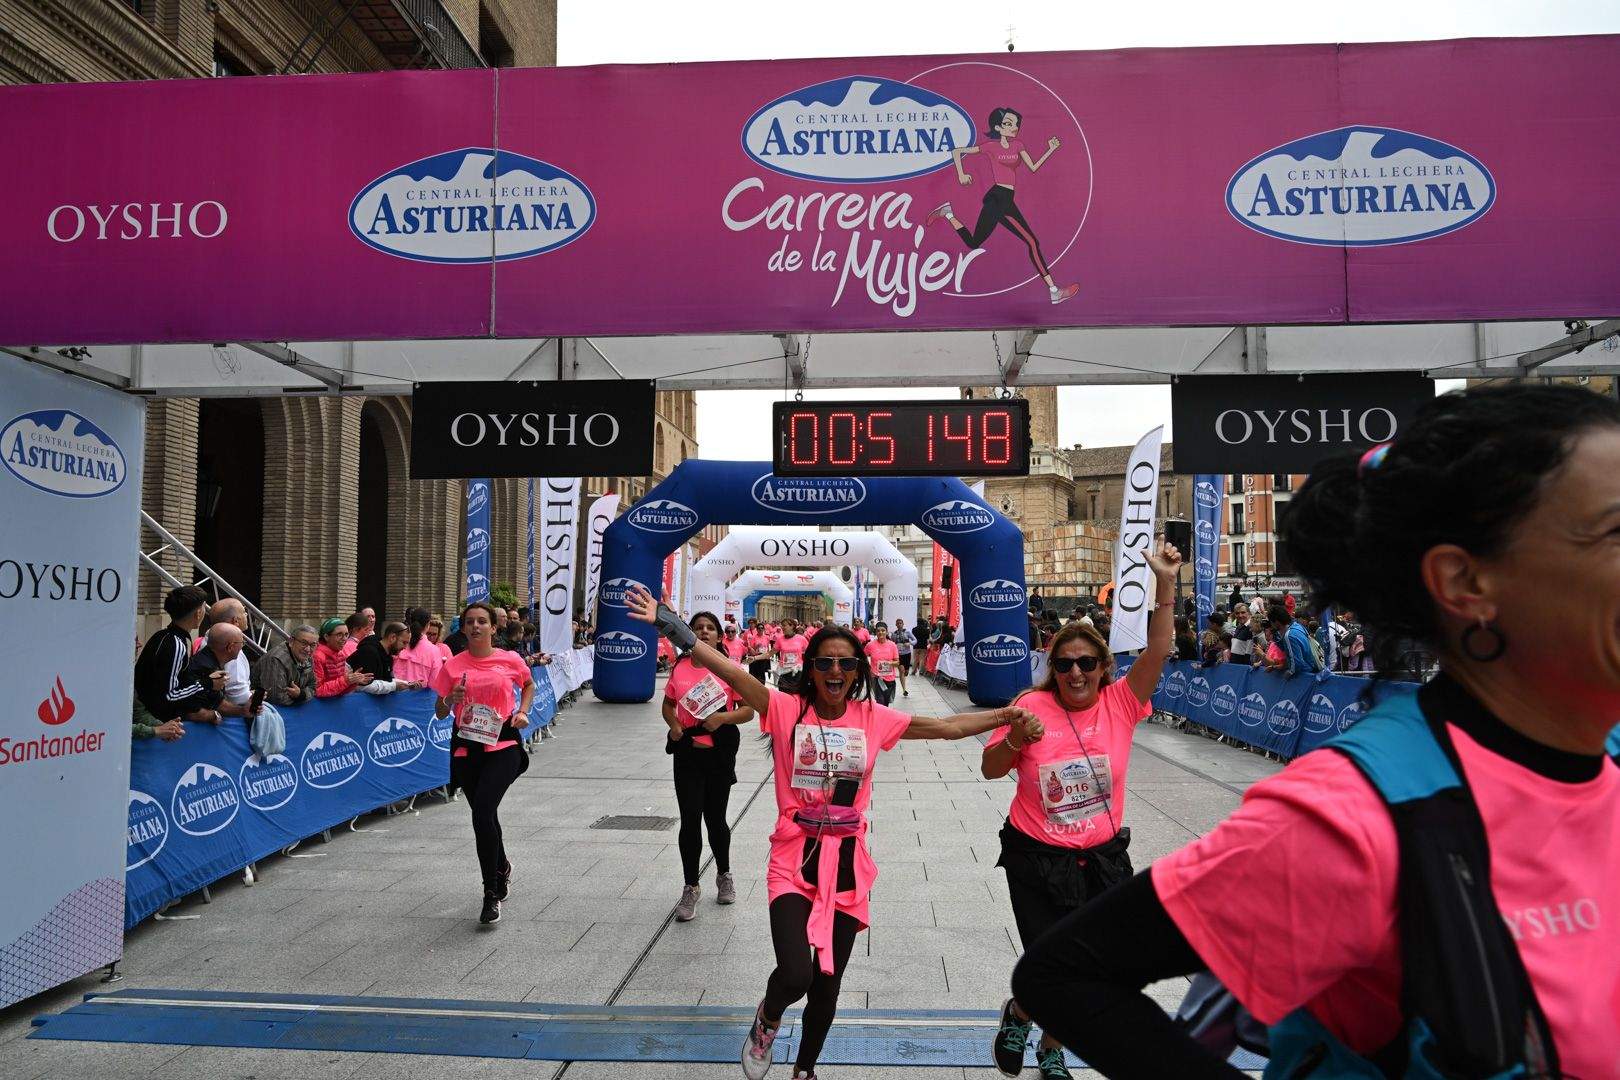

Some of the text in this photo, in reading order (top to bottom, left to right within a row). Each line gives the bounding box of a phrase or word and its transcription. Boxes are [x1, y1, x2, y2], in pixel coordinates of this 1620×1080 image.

[796, 111, 950, 125] CENTRAL LECHERA
[760, 117, 955, 156] ASTURIANA
[1288, 165, 1465, 181] CENTRAL LECHERA
[405, 185, 568, 201] CENTRAL LECHERA
[721, 177, 912, 232] Carrera
[1247, 173, 1475, 217] ASTURIANA
[47, 200, 228, 243] OYSHO
[367, 193, 577, 236] ASTURIANA
[767, 225, 987, 317] de la Mujer
[451, 412, 620, 447] OYSHO
[1215, 407, 1398, 444] OYSHO
[8, 430, 118, 482] ASTURIANA
[31, 432, 115, 458] CENTRAL LECHERA
[760, 481, 857, 501] ASTURIANA
[1246, 475, 1255, 514] OTEL
[632, 510, 692, 524] ASTURIANA
[928, 513, 990, 525] ASTURIANA
[760, 539, 849, 557] OYSHO
[1118, 461, 1155, 613] OYSHO
[708, 558, 735, 566] OYSHO
[0, 559, 121, 603] OYSHO
[974, 592, 1022, 603] ASTURIANA
[597, 643, 643, 654] ASTURIANA
[975, 646, 1025, 658] ASTURIANA
[0, 729, 105, 765] Santander
[373, 736, 422, 760] ASTURIANA
[819, 751, 843, 762] 016
[307, 751, 361, 780] ASTURIANA
[244, 772, 295, 800] ASTURIANA
[1065, 783, 1089, 794] 016
[179, 788, 237, 825] ASTURIANA
[128, 816, 165, 846] RIANA
[1502, 899, 1600, 941] YSHO
